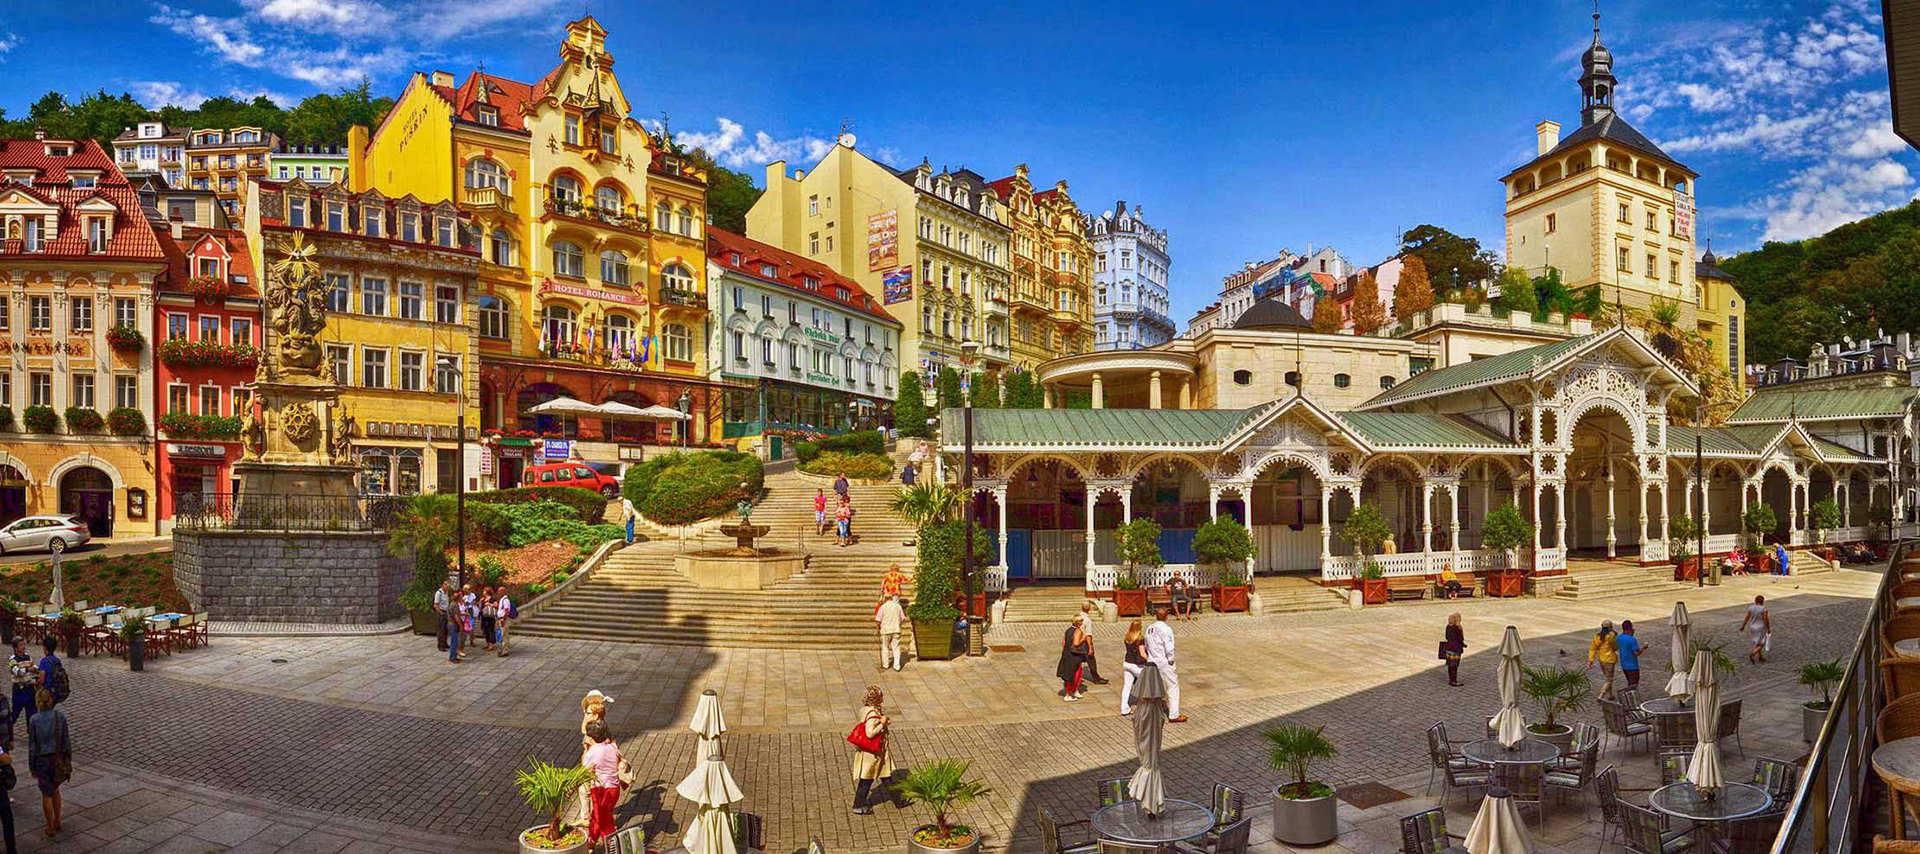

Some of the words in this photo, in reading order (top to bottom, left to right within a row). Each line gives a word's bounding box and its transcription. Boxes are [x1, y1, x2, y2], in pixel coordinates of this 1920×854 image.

[403, 108, 417, 133] HOTEL
[554, 284, 582, 295] HOTEL
[586, 289, 627, 302] ROMANCE
